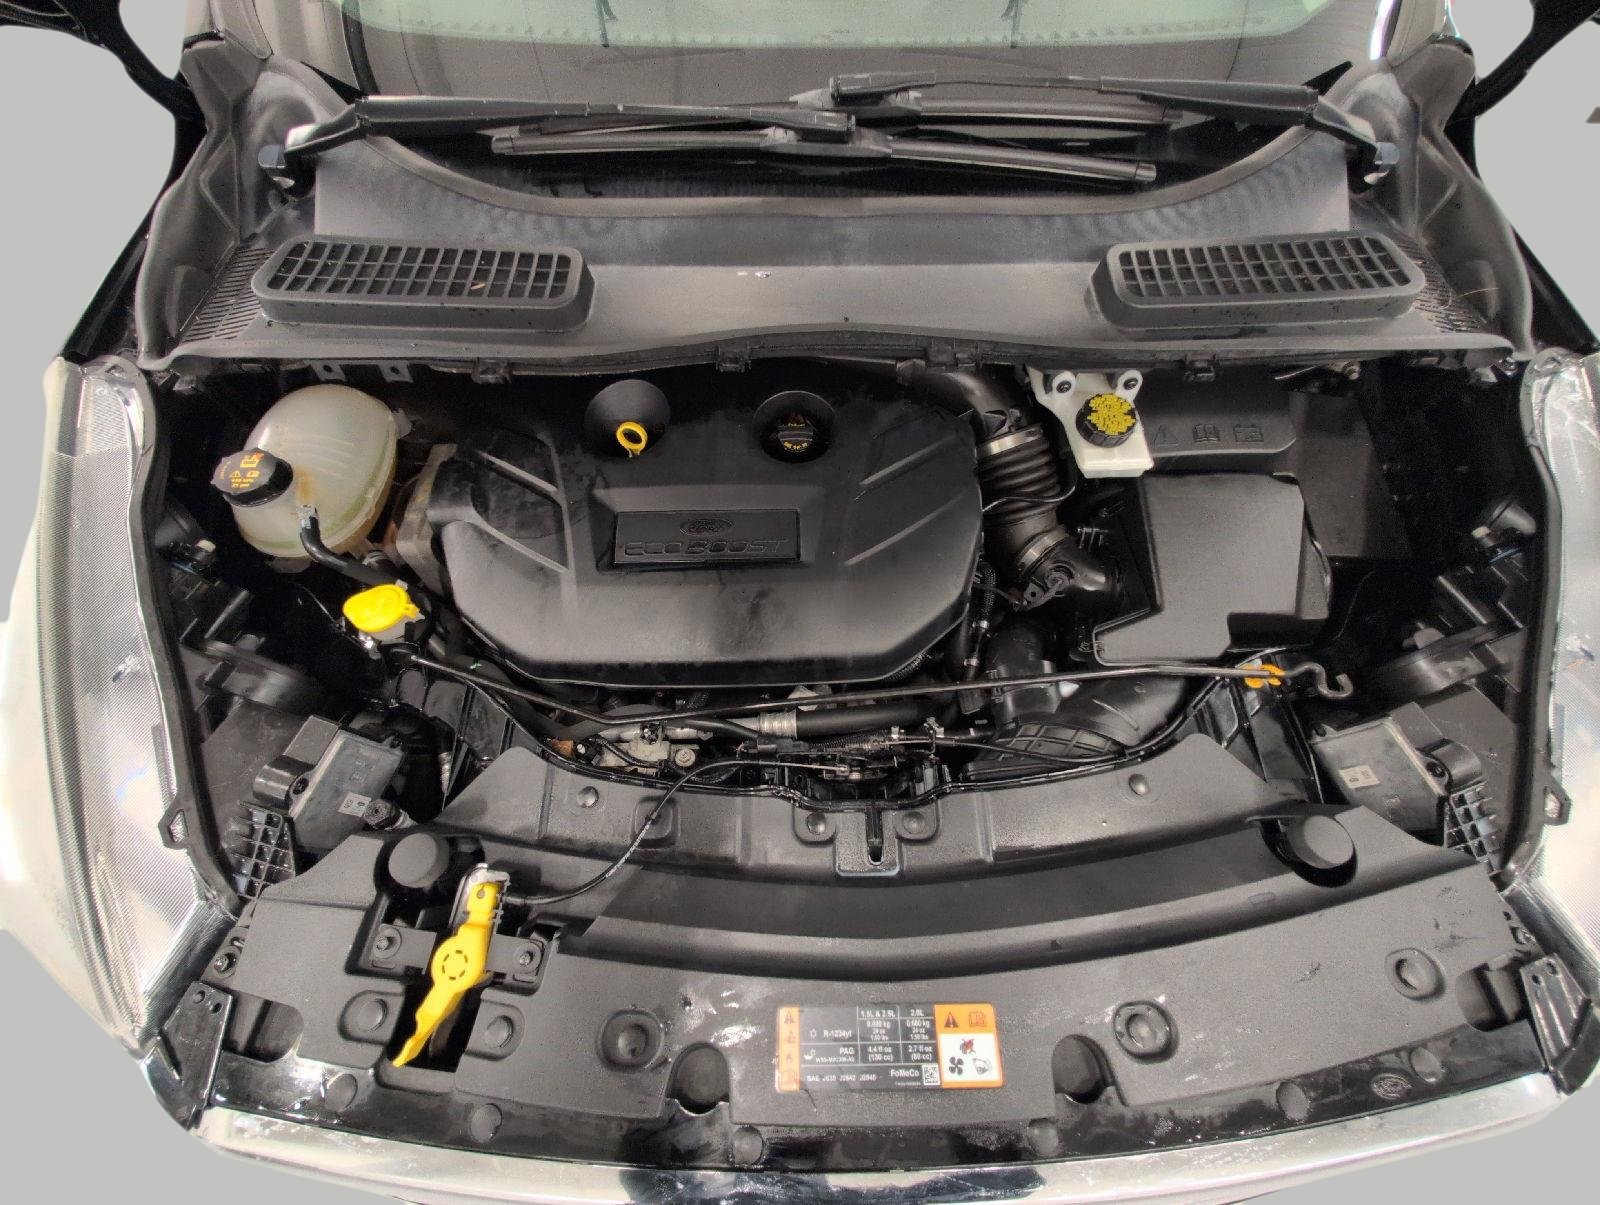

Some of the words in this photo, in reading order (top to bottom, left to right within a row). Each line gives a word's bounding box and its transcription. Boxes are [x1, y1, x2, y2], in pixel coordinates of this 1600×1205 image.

[823, 1029, 852, 1038] R-1234yf
[839, 1047, 855, 1055] PAG
[883, 1053, 894, 1062] cc)
[922, 1053, 932, 1061] cc)
[890, 1069, 920, 1077] FoMoCo
